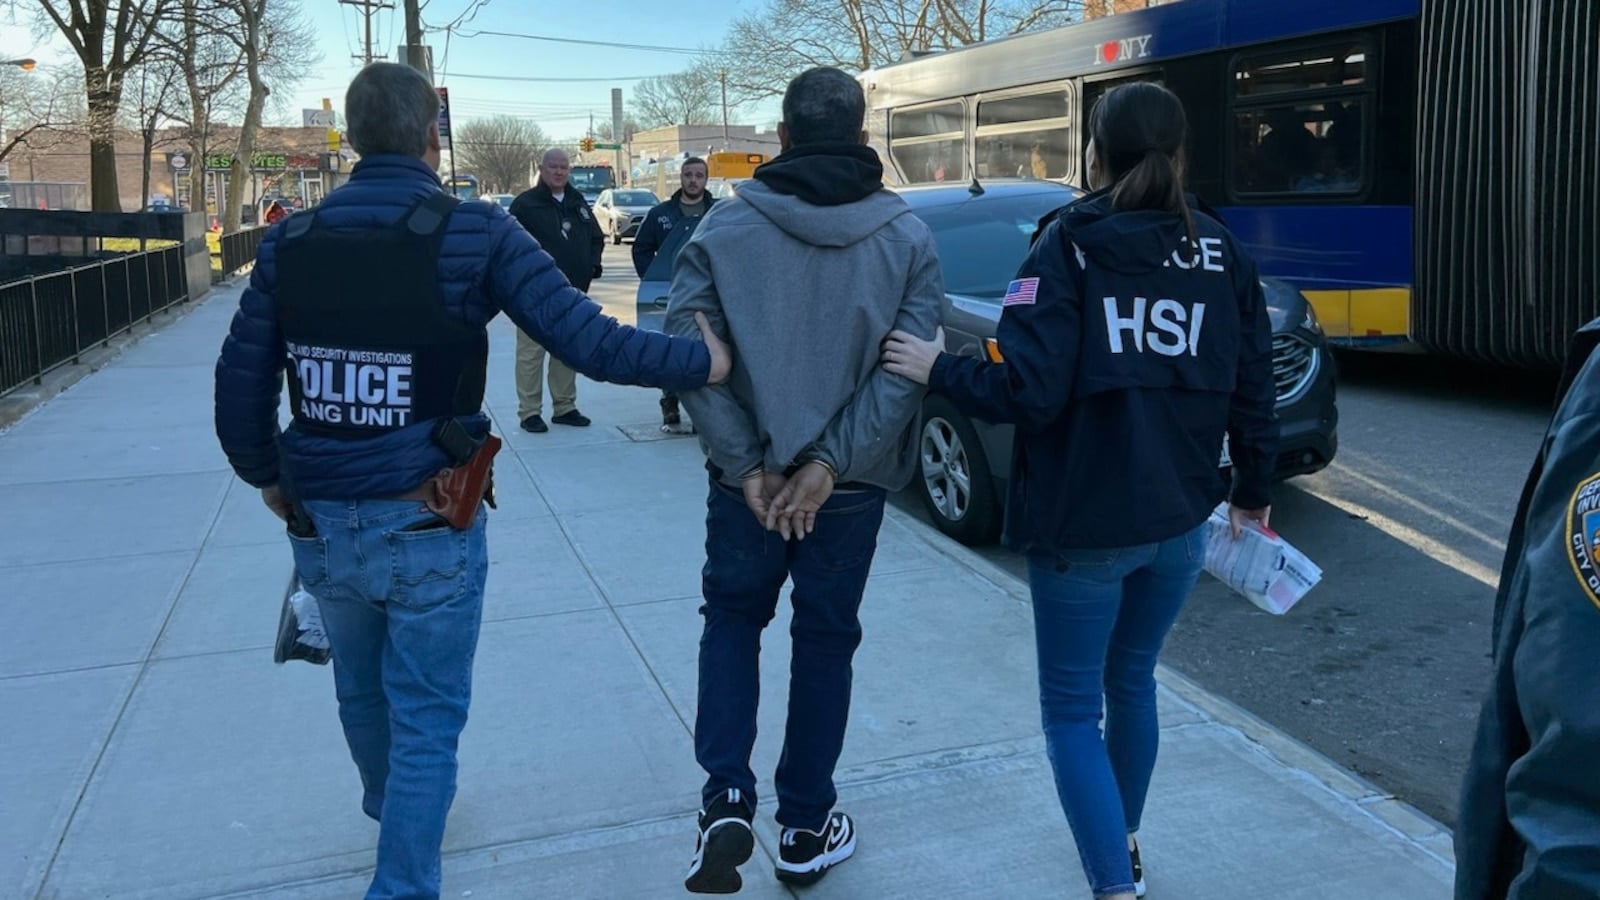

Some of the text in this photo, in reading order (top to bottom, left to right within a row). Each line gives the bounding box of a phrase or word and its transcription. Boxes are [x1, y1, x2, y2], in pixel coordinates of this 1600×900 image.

[1093, 34, 1152, 65] I NY
[1103, 296, 1206, 357] HSI
[311, 346, 347, 361] SECURITY
[349, 350, 412, 365] INVESTIGATIONS
[301, 400, 411, 427] ANG UNIT
[1573, 533, 1592, 569] CITY
